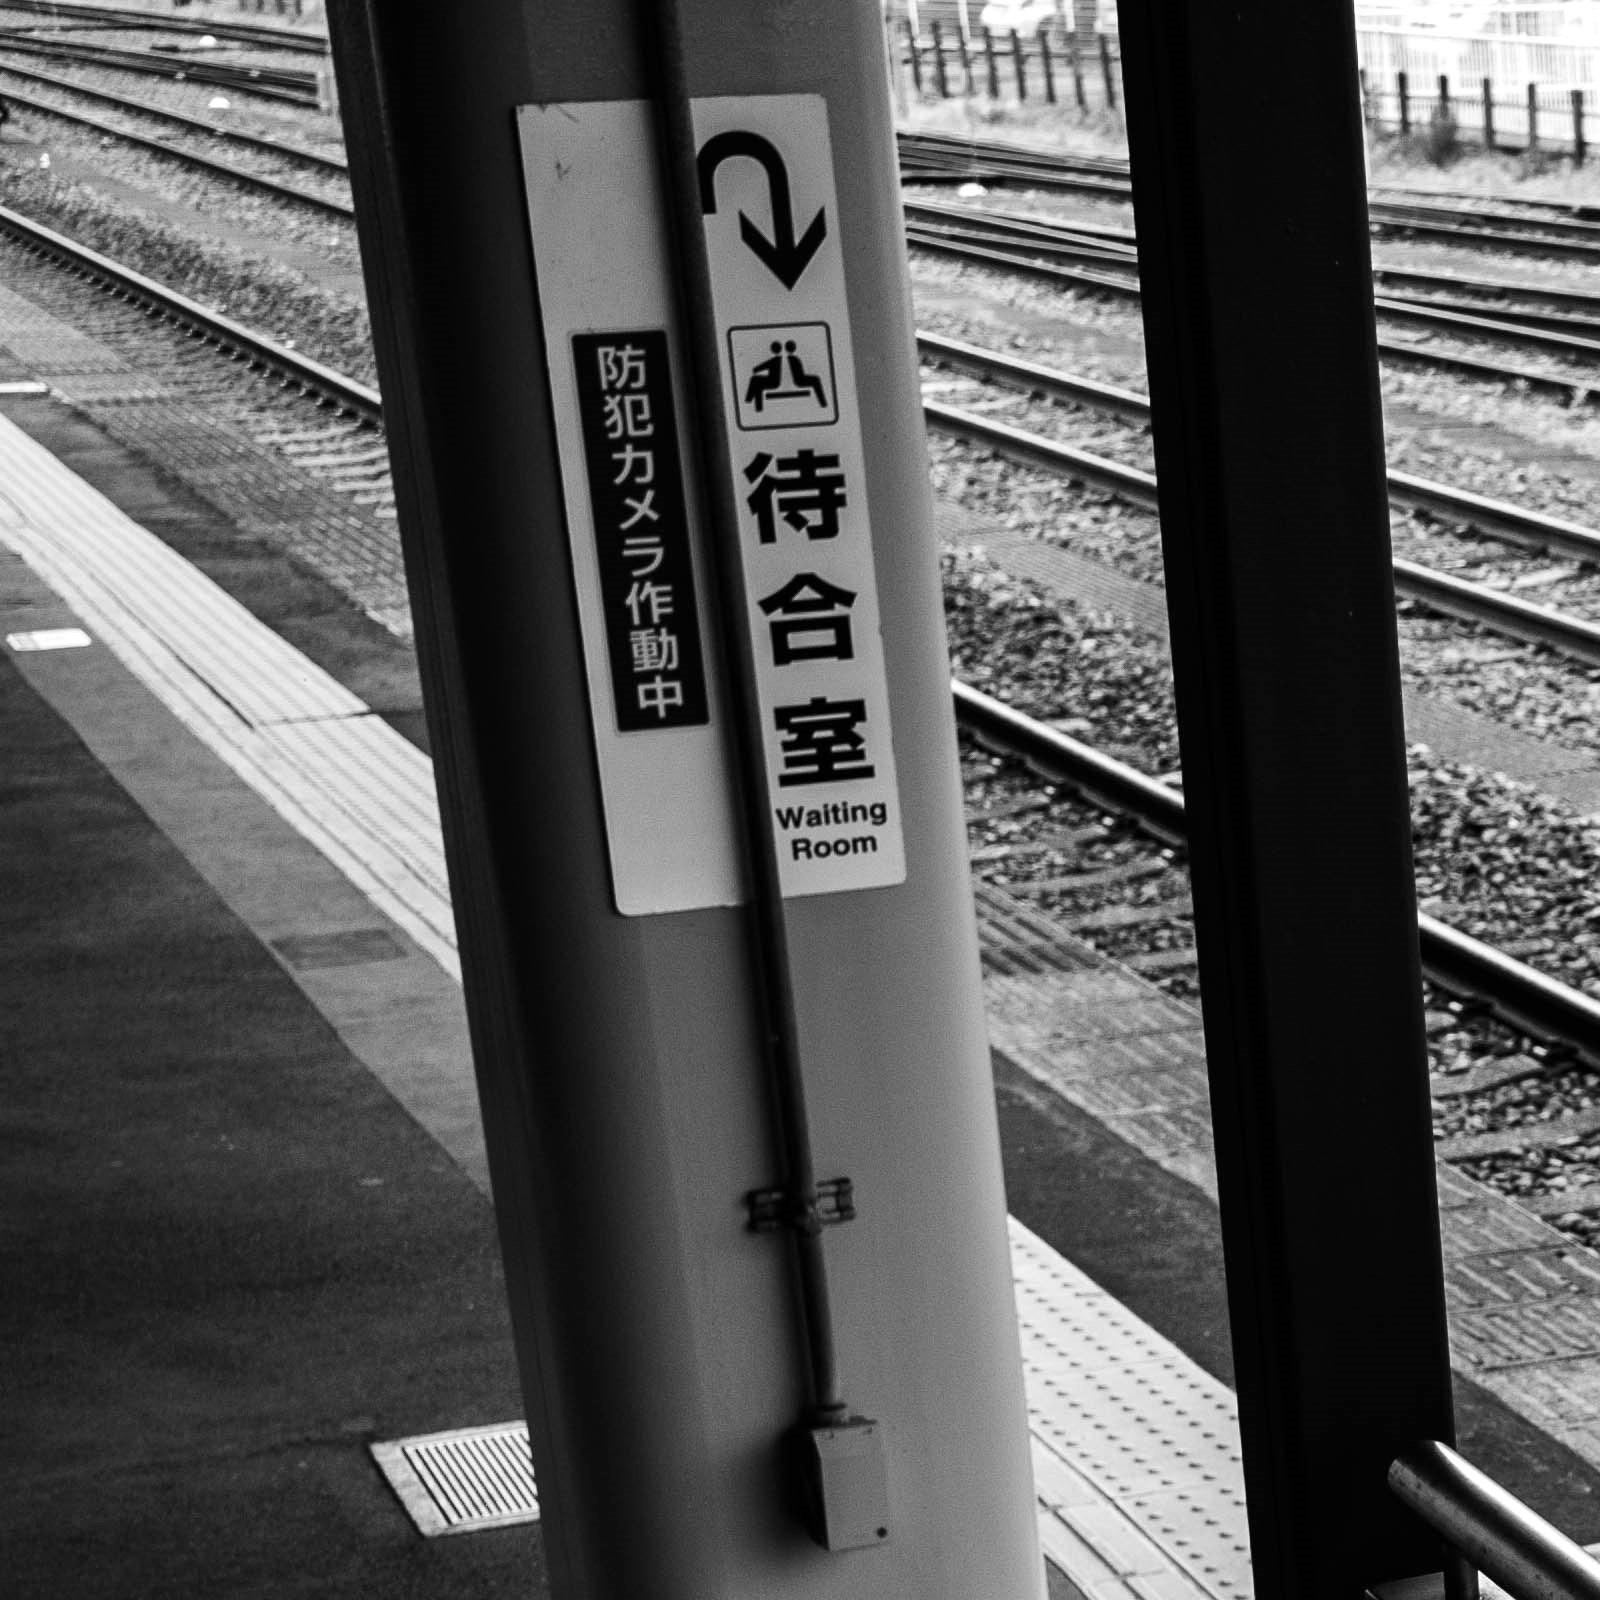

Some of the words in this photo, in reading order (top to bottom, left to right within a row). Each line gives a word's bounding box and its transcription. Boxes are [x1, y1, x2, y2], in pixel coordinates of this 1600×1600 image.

[598, 344, 683, 718] 防犯カメラ作動中
[743, 449, 875, 787] 待合室
[776, 801, 888, 830] Waiting
[791, 835, 878, 861] Room
